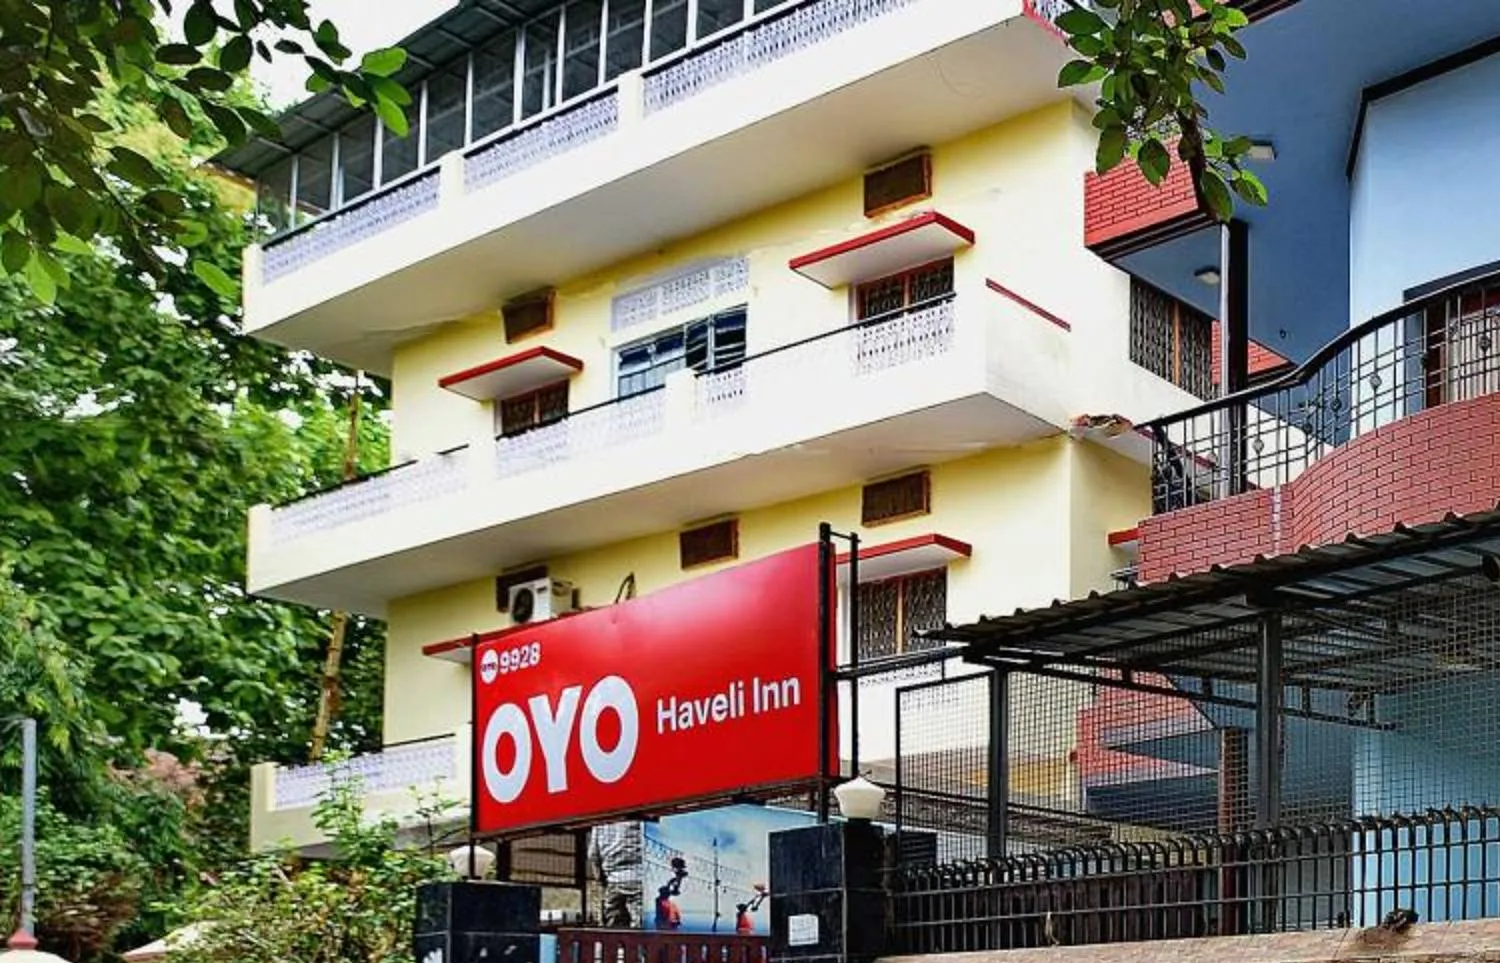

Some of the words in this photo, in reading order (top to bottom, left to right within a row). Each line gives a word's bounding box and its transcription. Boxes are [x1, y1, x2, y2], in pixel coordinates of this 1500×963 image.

[499, 641, 541, 675] 9928
[657, 680, 745, 735] Haveli
[753, 676, 800, 714] Inn
[481, 675, 639, 803] OYO
